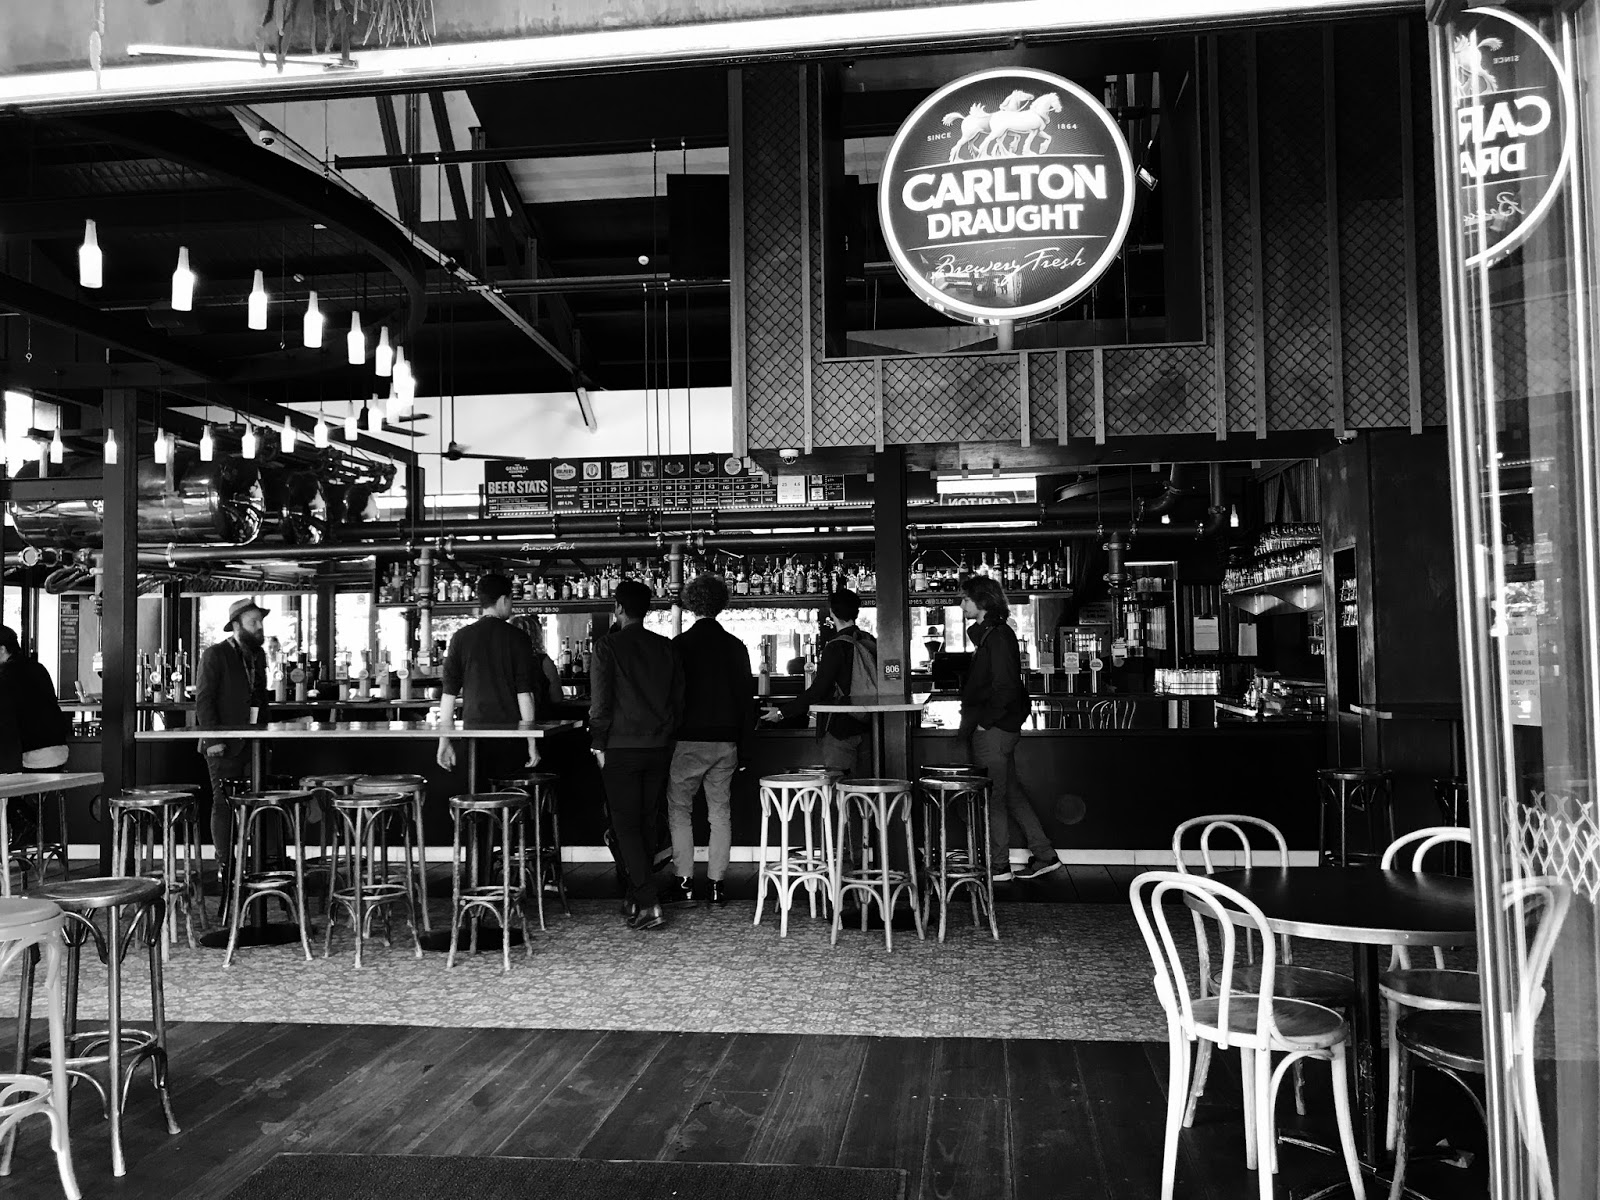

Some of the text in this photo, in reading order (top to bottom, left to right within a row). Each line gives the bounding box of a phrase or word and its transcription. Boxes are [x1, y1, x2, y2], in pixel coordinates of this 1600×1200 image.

[927, 122, 1078, 142] SINCE 1864
[902, 163, 1108, 212] CARLTON
[926, 203, 1084, 240] DRAUGHT
[930, 246, 1086, 286] Brewery Fresh
[488, 481, 516, 494] BEER
[517, 479, 548, 494] STATS
[519, 541, 576, 553] Brewery Fresh
[885, 664, 900, 674] 806
